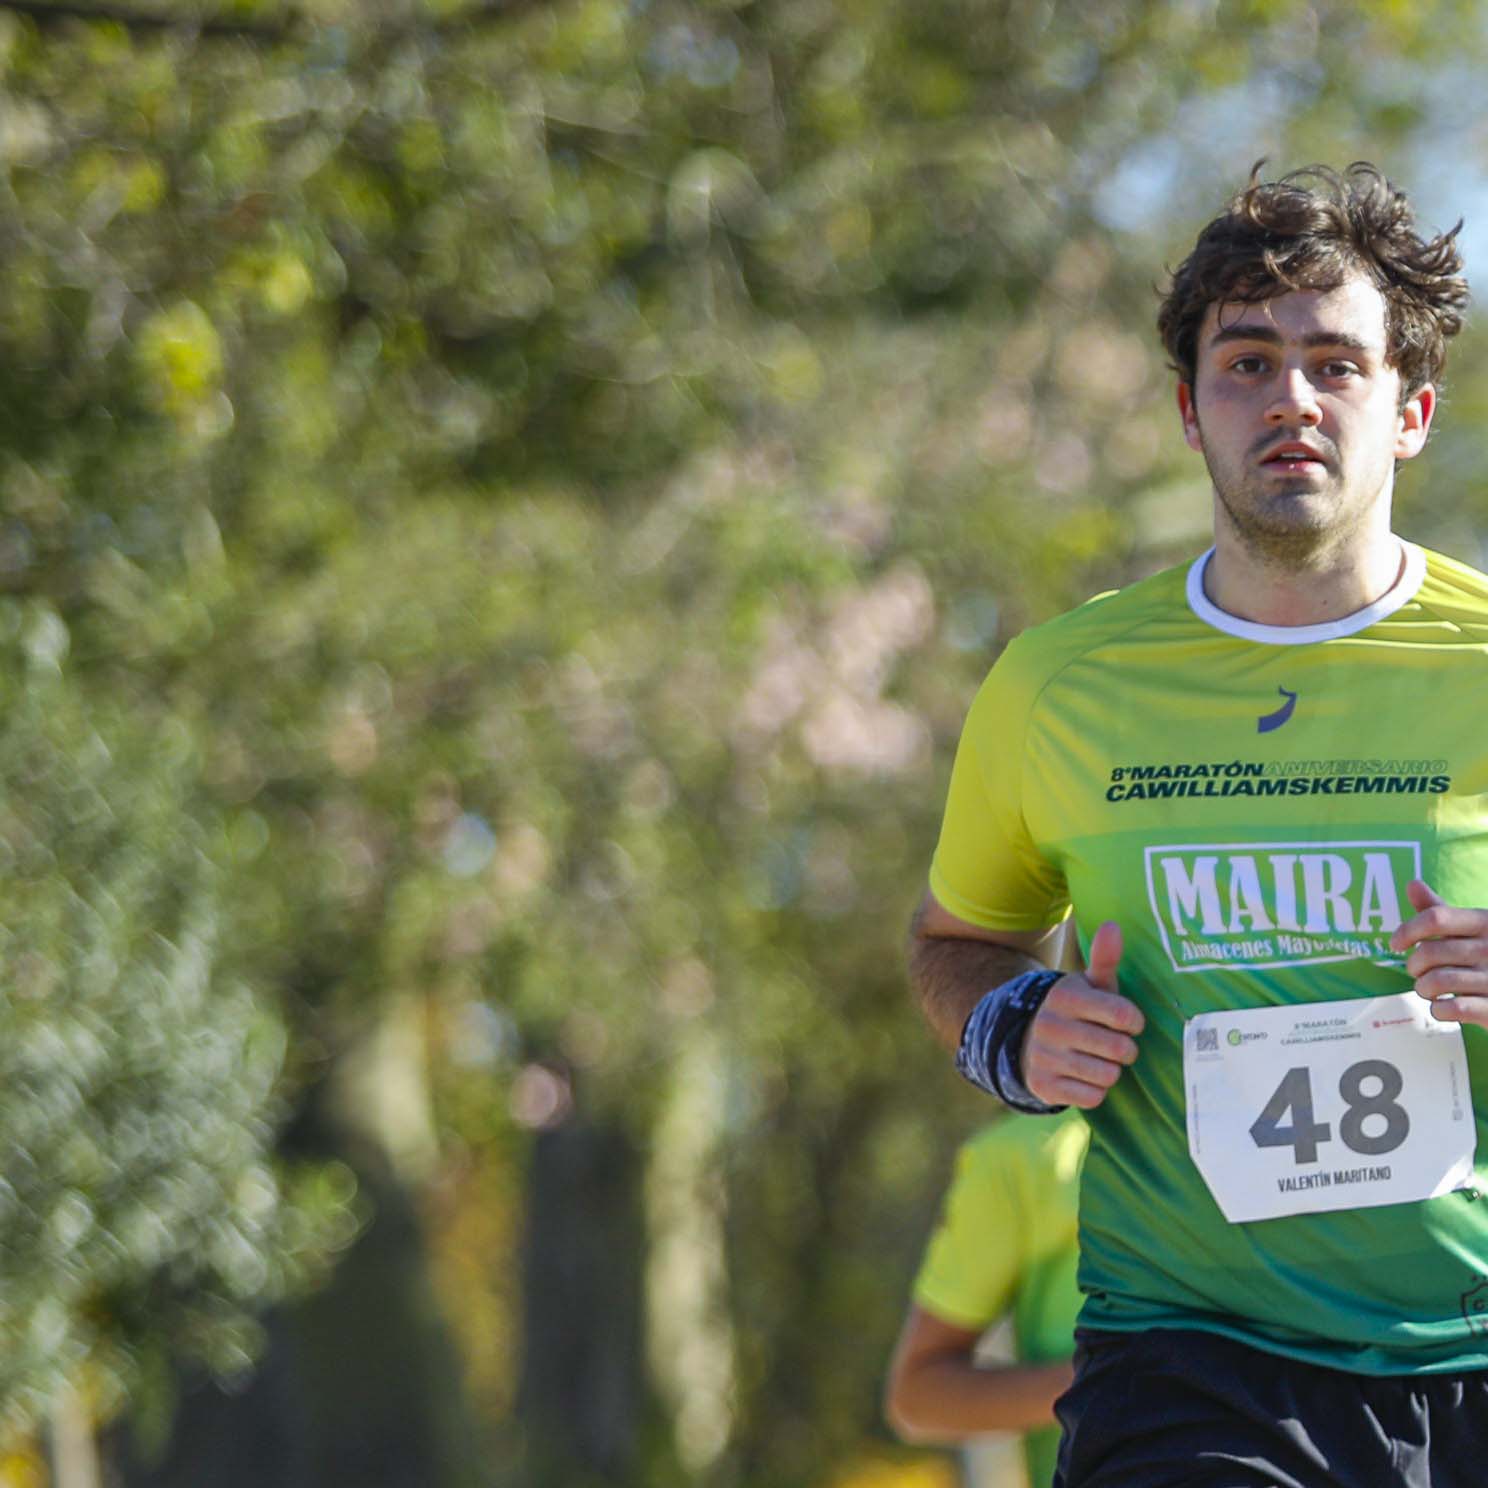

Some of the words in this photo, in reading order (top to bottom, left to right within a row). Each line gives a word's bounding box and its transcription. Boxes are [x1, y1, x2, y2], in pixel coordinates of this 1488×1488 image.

[1262, 759, 1448, 776] ANIVERSARIO
[1106, 775, 1451, 802] CAWILLIAMSKEMMIS
[1160, 852, 1403, 937] MAIRA
[1181, 938, 1273, 961] Almacenes
[1249, 1058, 1411, 1165] 48
[1278, 1170, 1331, 1193] VALENTÍN
[1332, 1165, 1392, 1185] MARITANO
